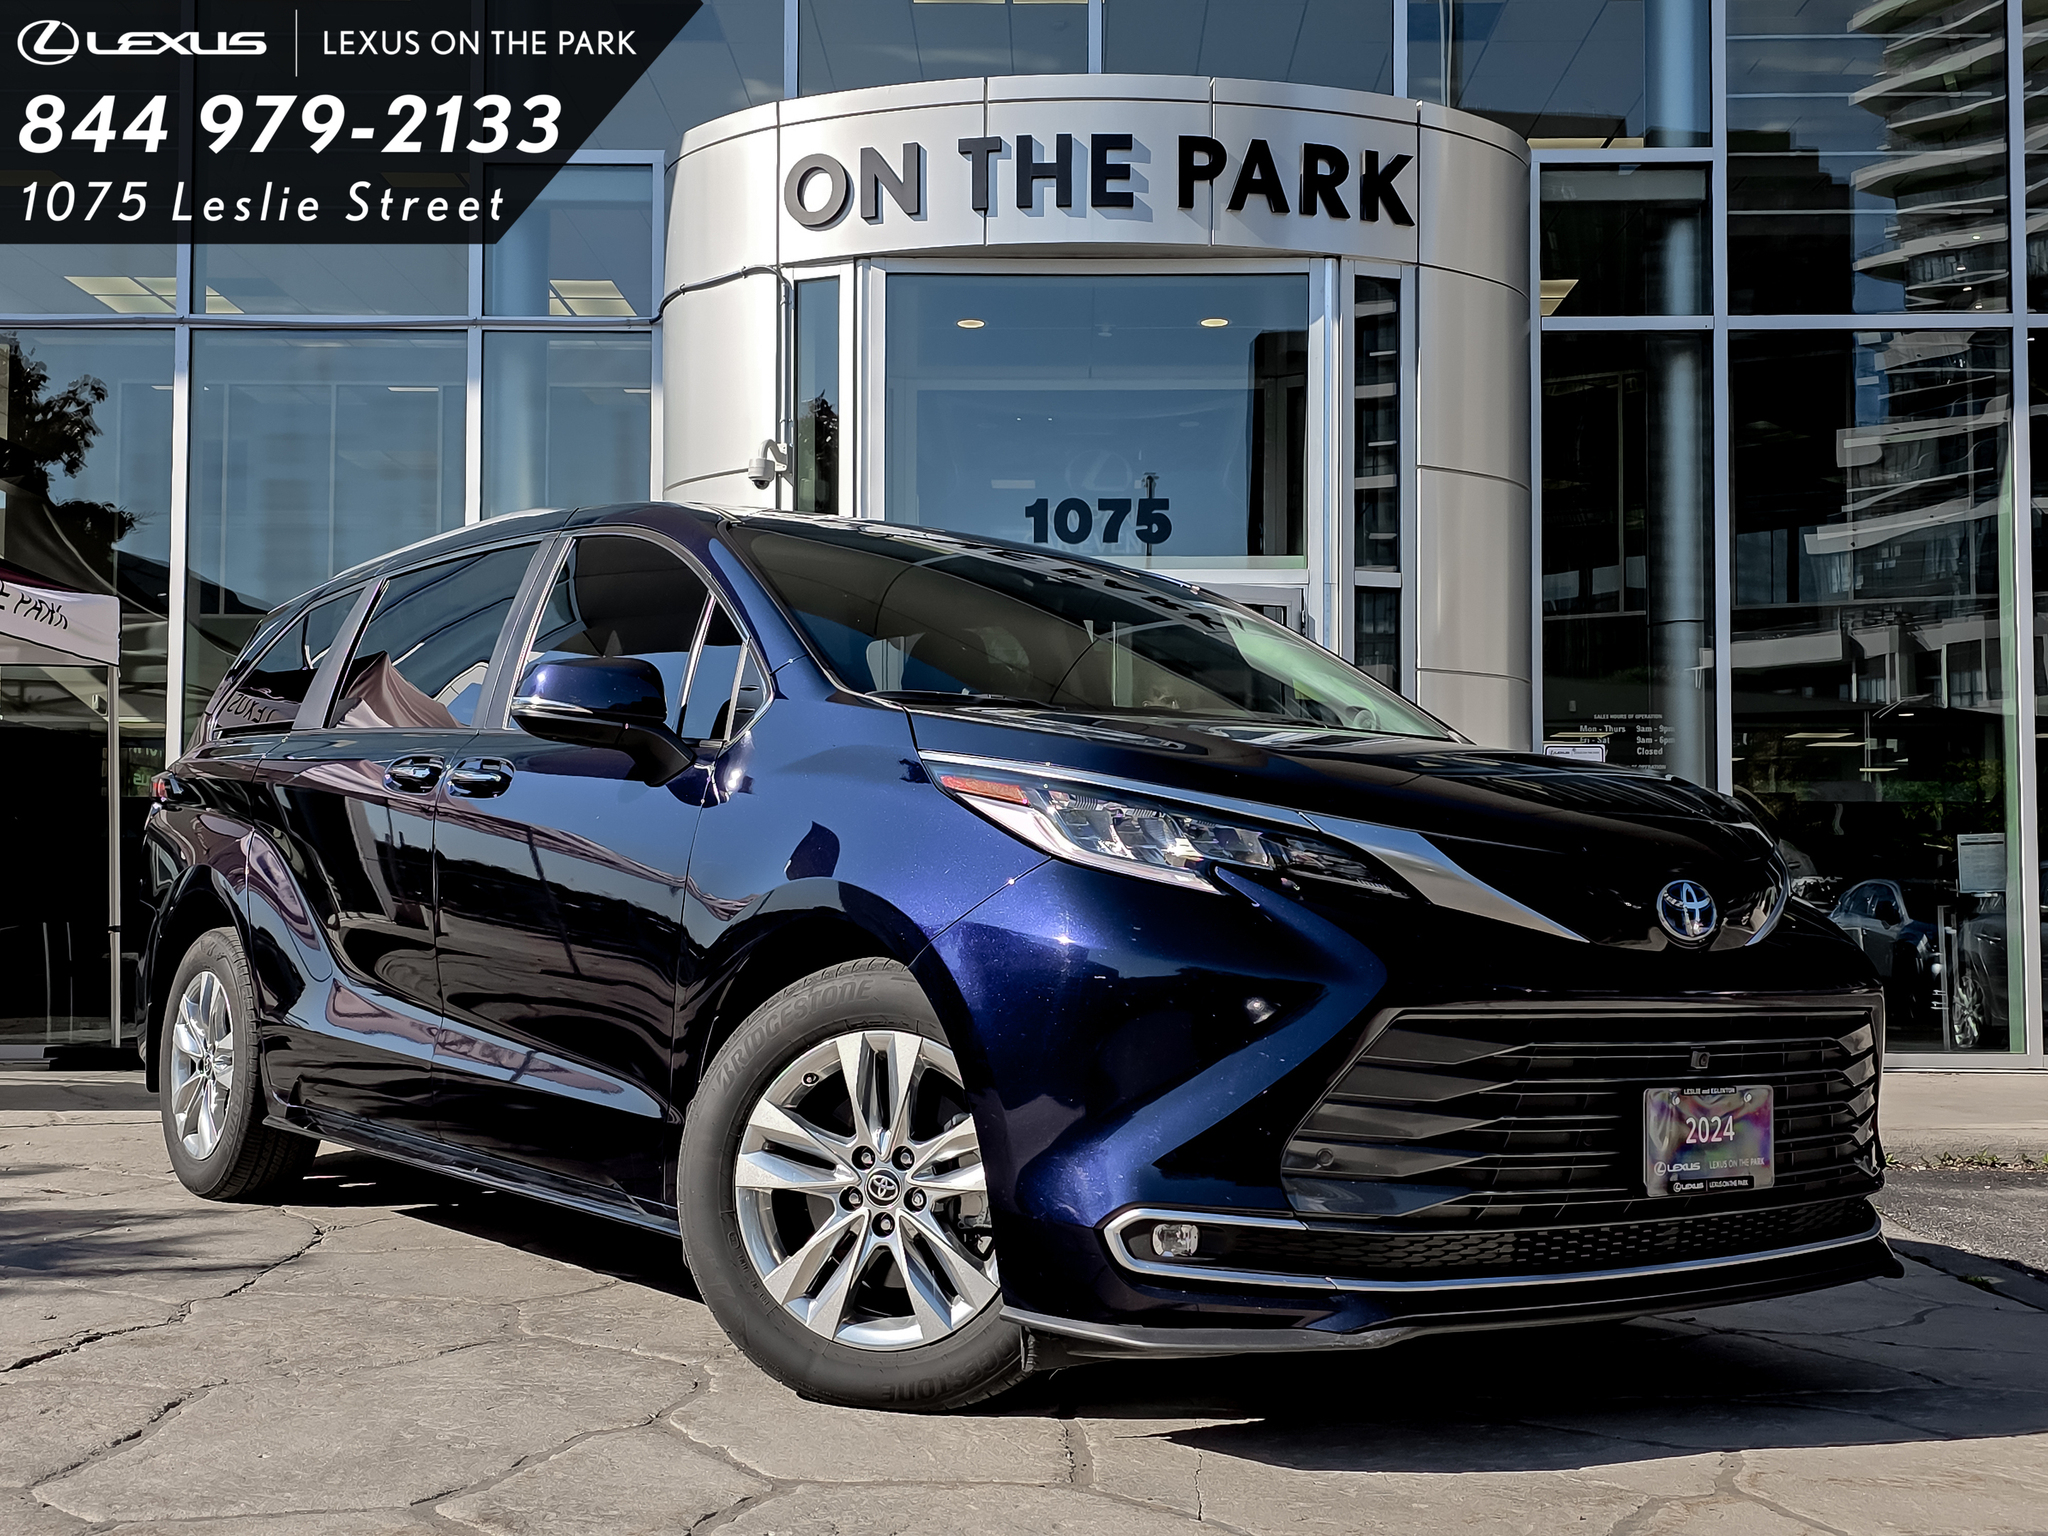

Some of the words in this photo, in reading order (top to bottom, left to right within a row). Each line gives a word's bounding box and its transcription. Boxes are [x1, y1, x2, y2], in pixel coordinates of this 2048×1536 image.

[784, 140, 926, 230] ON
[958, 134, 1135, 213] THE
[1178, 135, 1415, 227] PARK
[1025, 498, 1172, 544] 1075
[1604, 725, 1626, 733] Thurs
[1659, 725, 1675, 734] 9pm
[1636, 736, 1652, 744] 9am
[1636, 747, 1663, 755] Closed
[717, 979, 874, 1094] BRIDGESTONE
[1686, 1115, 1735, 1144] 2024
[1667, 1162, 1701, 1172] LEXUS
[1709, 1160, 1727, 1169] LEXUS
[1729, 1159, 1737, 1168] ON
[1739, 1158, 1749, 1167] THE
[1751, 1157, 1765, 1166] PARK
